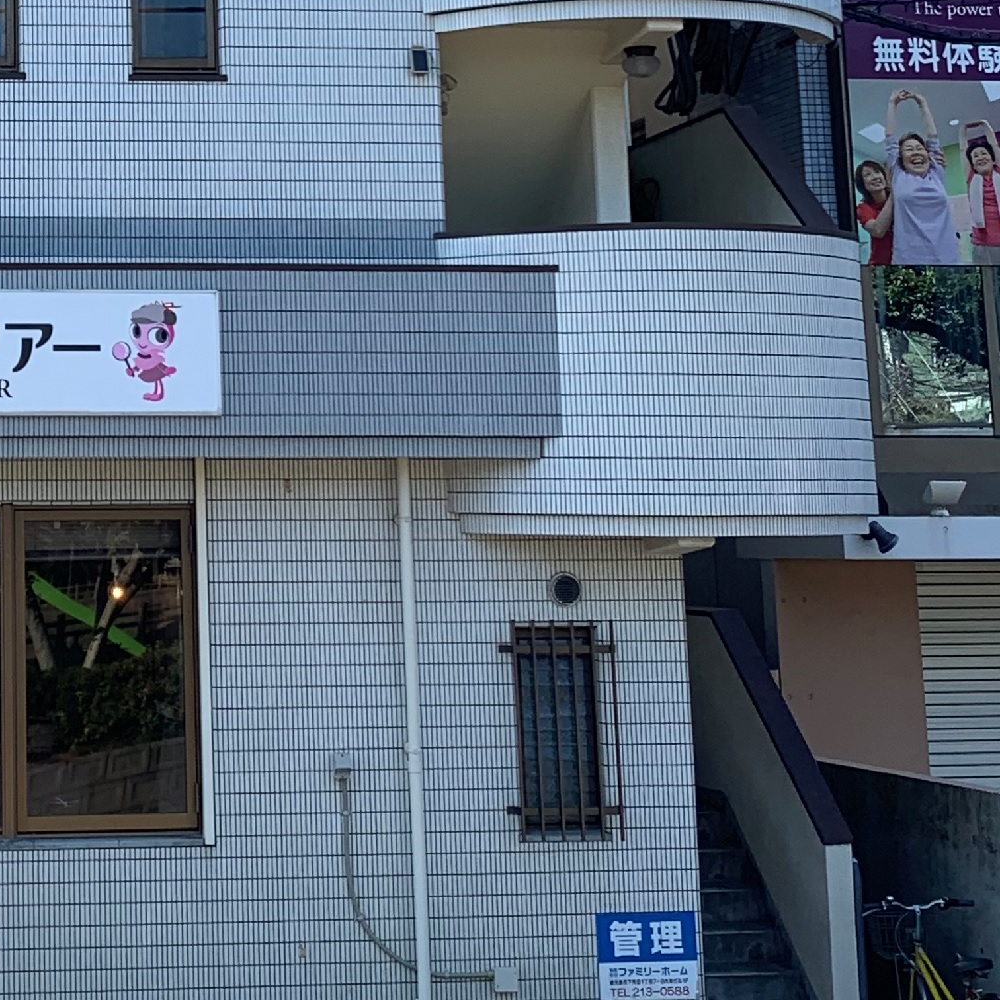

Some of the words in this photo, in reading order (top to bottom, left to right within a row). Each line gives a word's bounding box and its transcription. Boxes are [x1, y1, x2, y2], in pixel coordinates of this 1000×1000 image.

[914, 1, 942, 16] The
[947, 4, 993, 20] power
[609, 920, 684, 957] 管理
[610, 988, 631, 997] TEL
